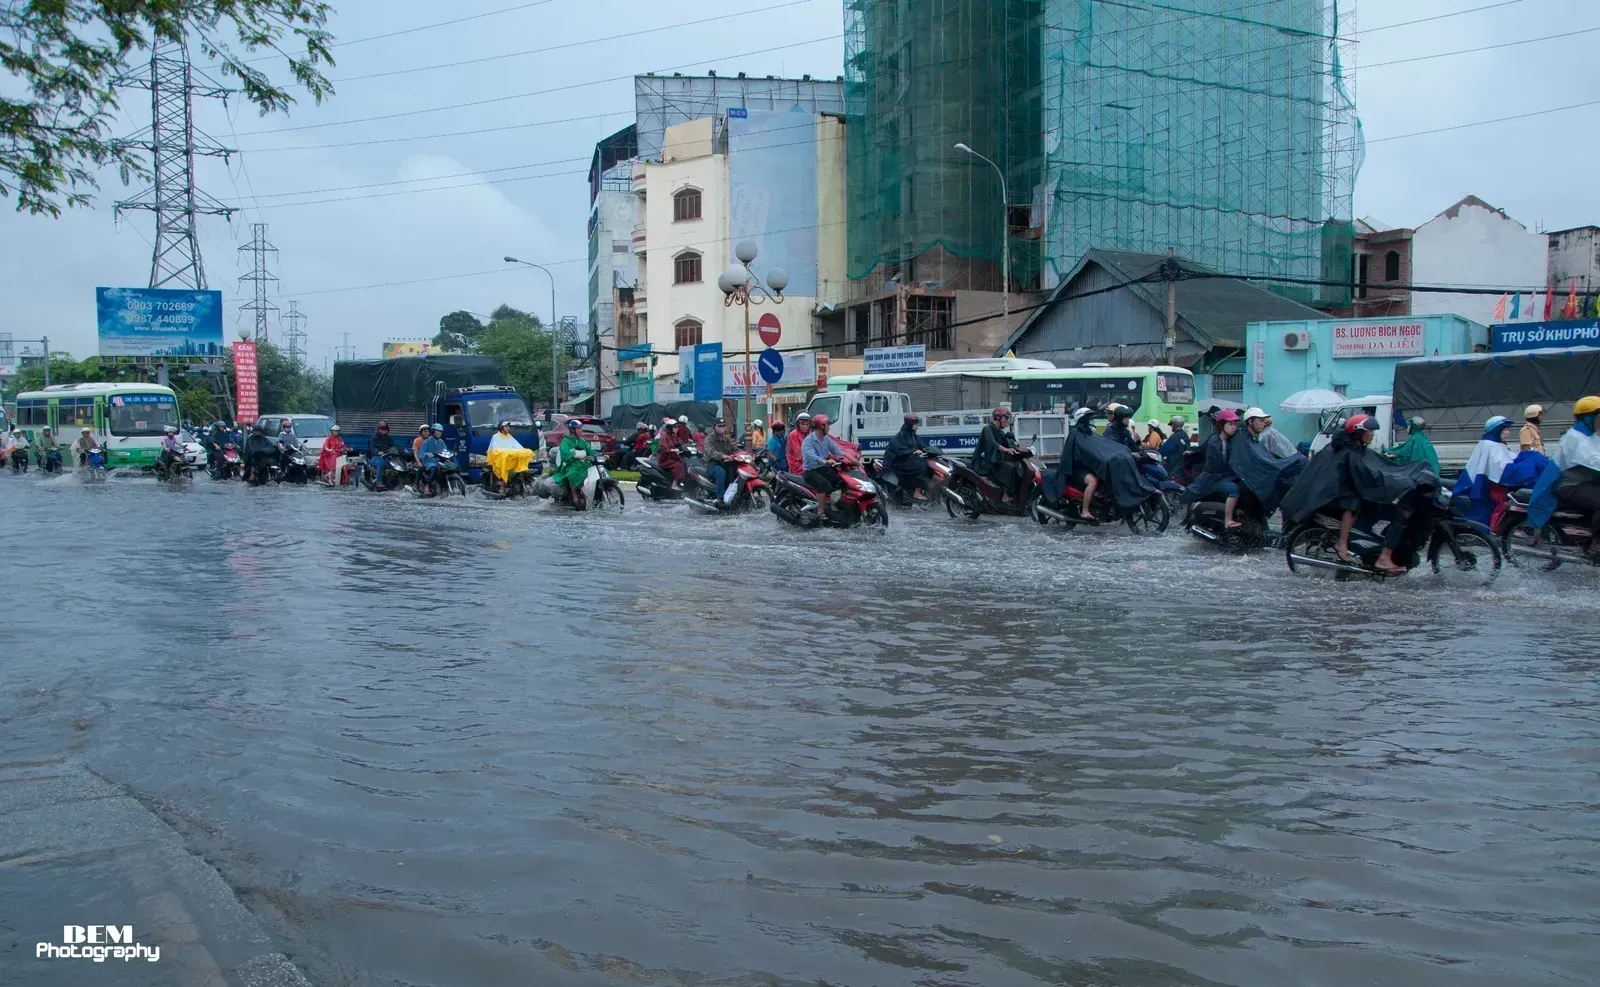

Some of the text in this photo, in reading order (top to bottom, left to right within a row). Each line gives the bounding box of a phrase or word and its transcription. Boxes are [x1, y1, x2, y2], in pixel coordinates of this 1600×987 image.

[127, 301, 194, 311] 0903 702689
[128, 314, 194, 324] 0987 440899
[1335, 328, 1348, 338] BS.
[1378, 324, 1397, 336] BÍCH
[1399, 325, 1421, 338] NGỌC
[1501, 322, 1599, 345] TRỤ SỞ KHU PHỐ
[1368, 341, 1385, 349] DA
[1389, 337, 1419, 349] LIỄU
